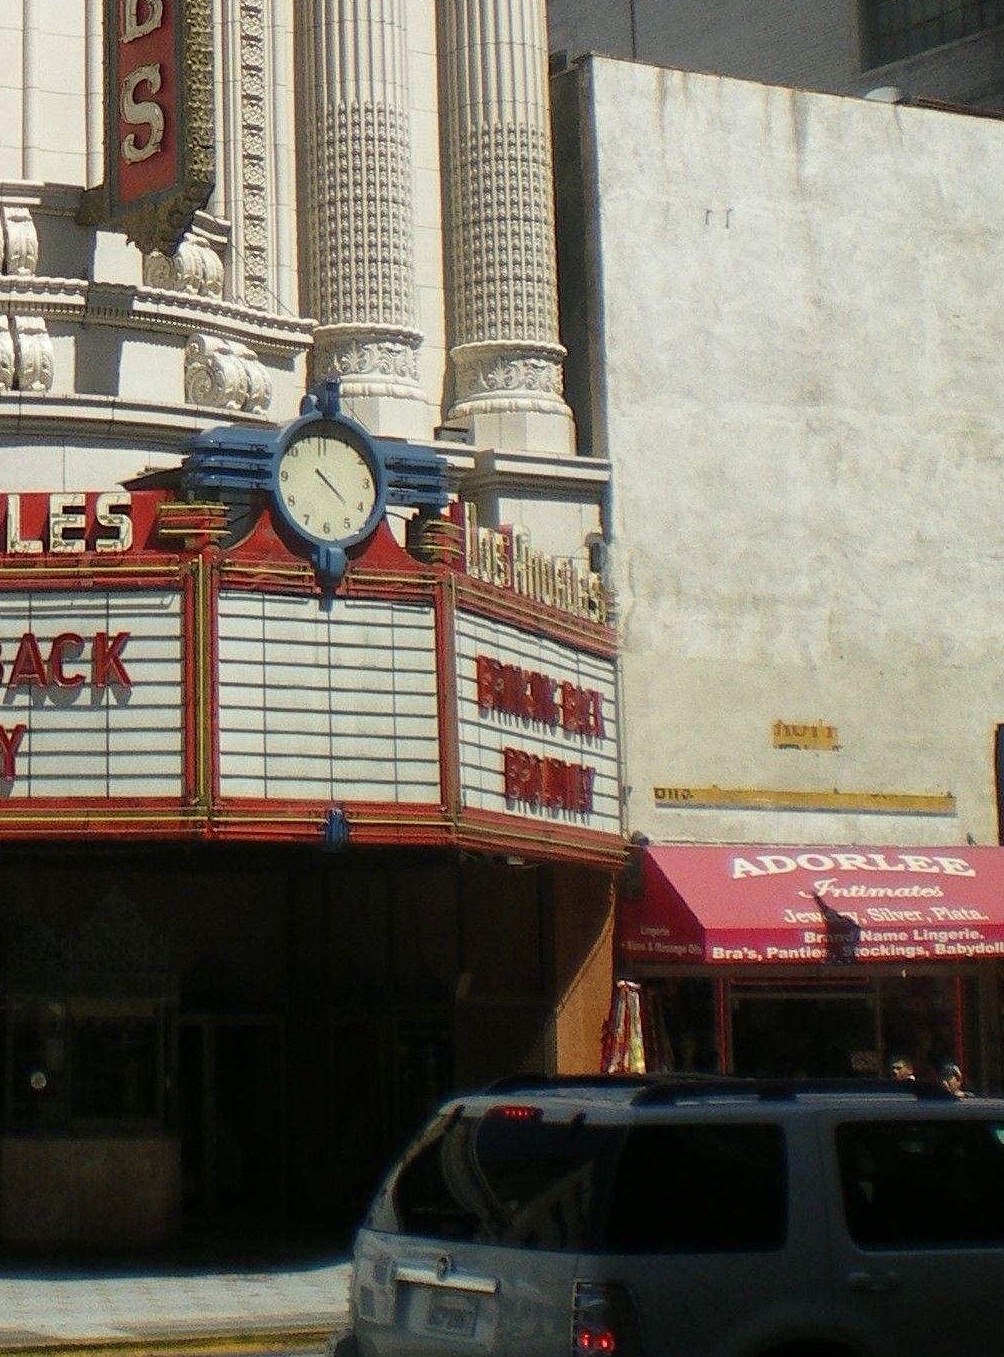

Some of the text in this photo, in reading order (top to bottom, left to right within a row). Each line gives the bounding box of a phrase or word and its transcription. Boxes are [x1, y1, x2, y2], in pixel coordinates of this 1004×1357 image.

[280, 470, 288, 482] 9
[362, 478, 370, 490] 3
[287, 496, 296, 507] 8
[357, 502, 364, 513] 4
[302, 514, 310, 526] 7
[343, 518, 351, 530] 5
[322, 523, 331, 534] 6
[732, 853, 976, 879] ADORLEE
[798, 878, 944, 898] Intimates
[868, 907, 931, 923] Silver,
[930, 906, 989, 921] Plata.
[804, 929, 985, 944] Brand Name Lingerie.
[712, 946, 762, 961] Bra's,
[842, 944, 930, 959] Stockings,
